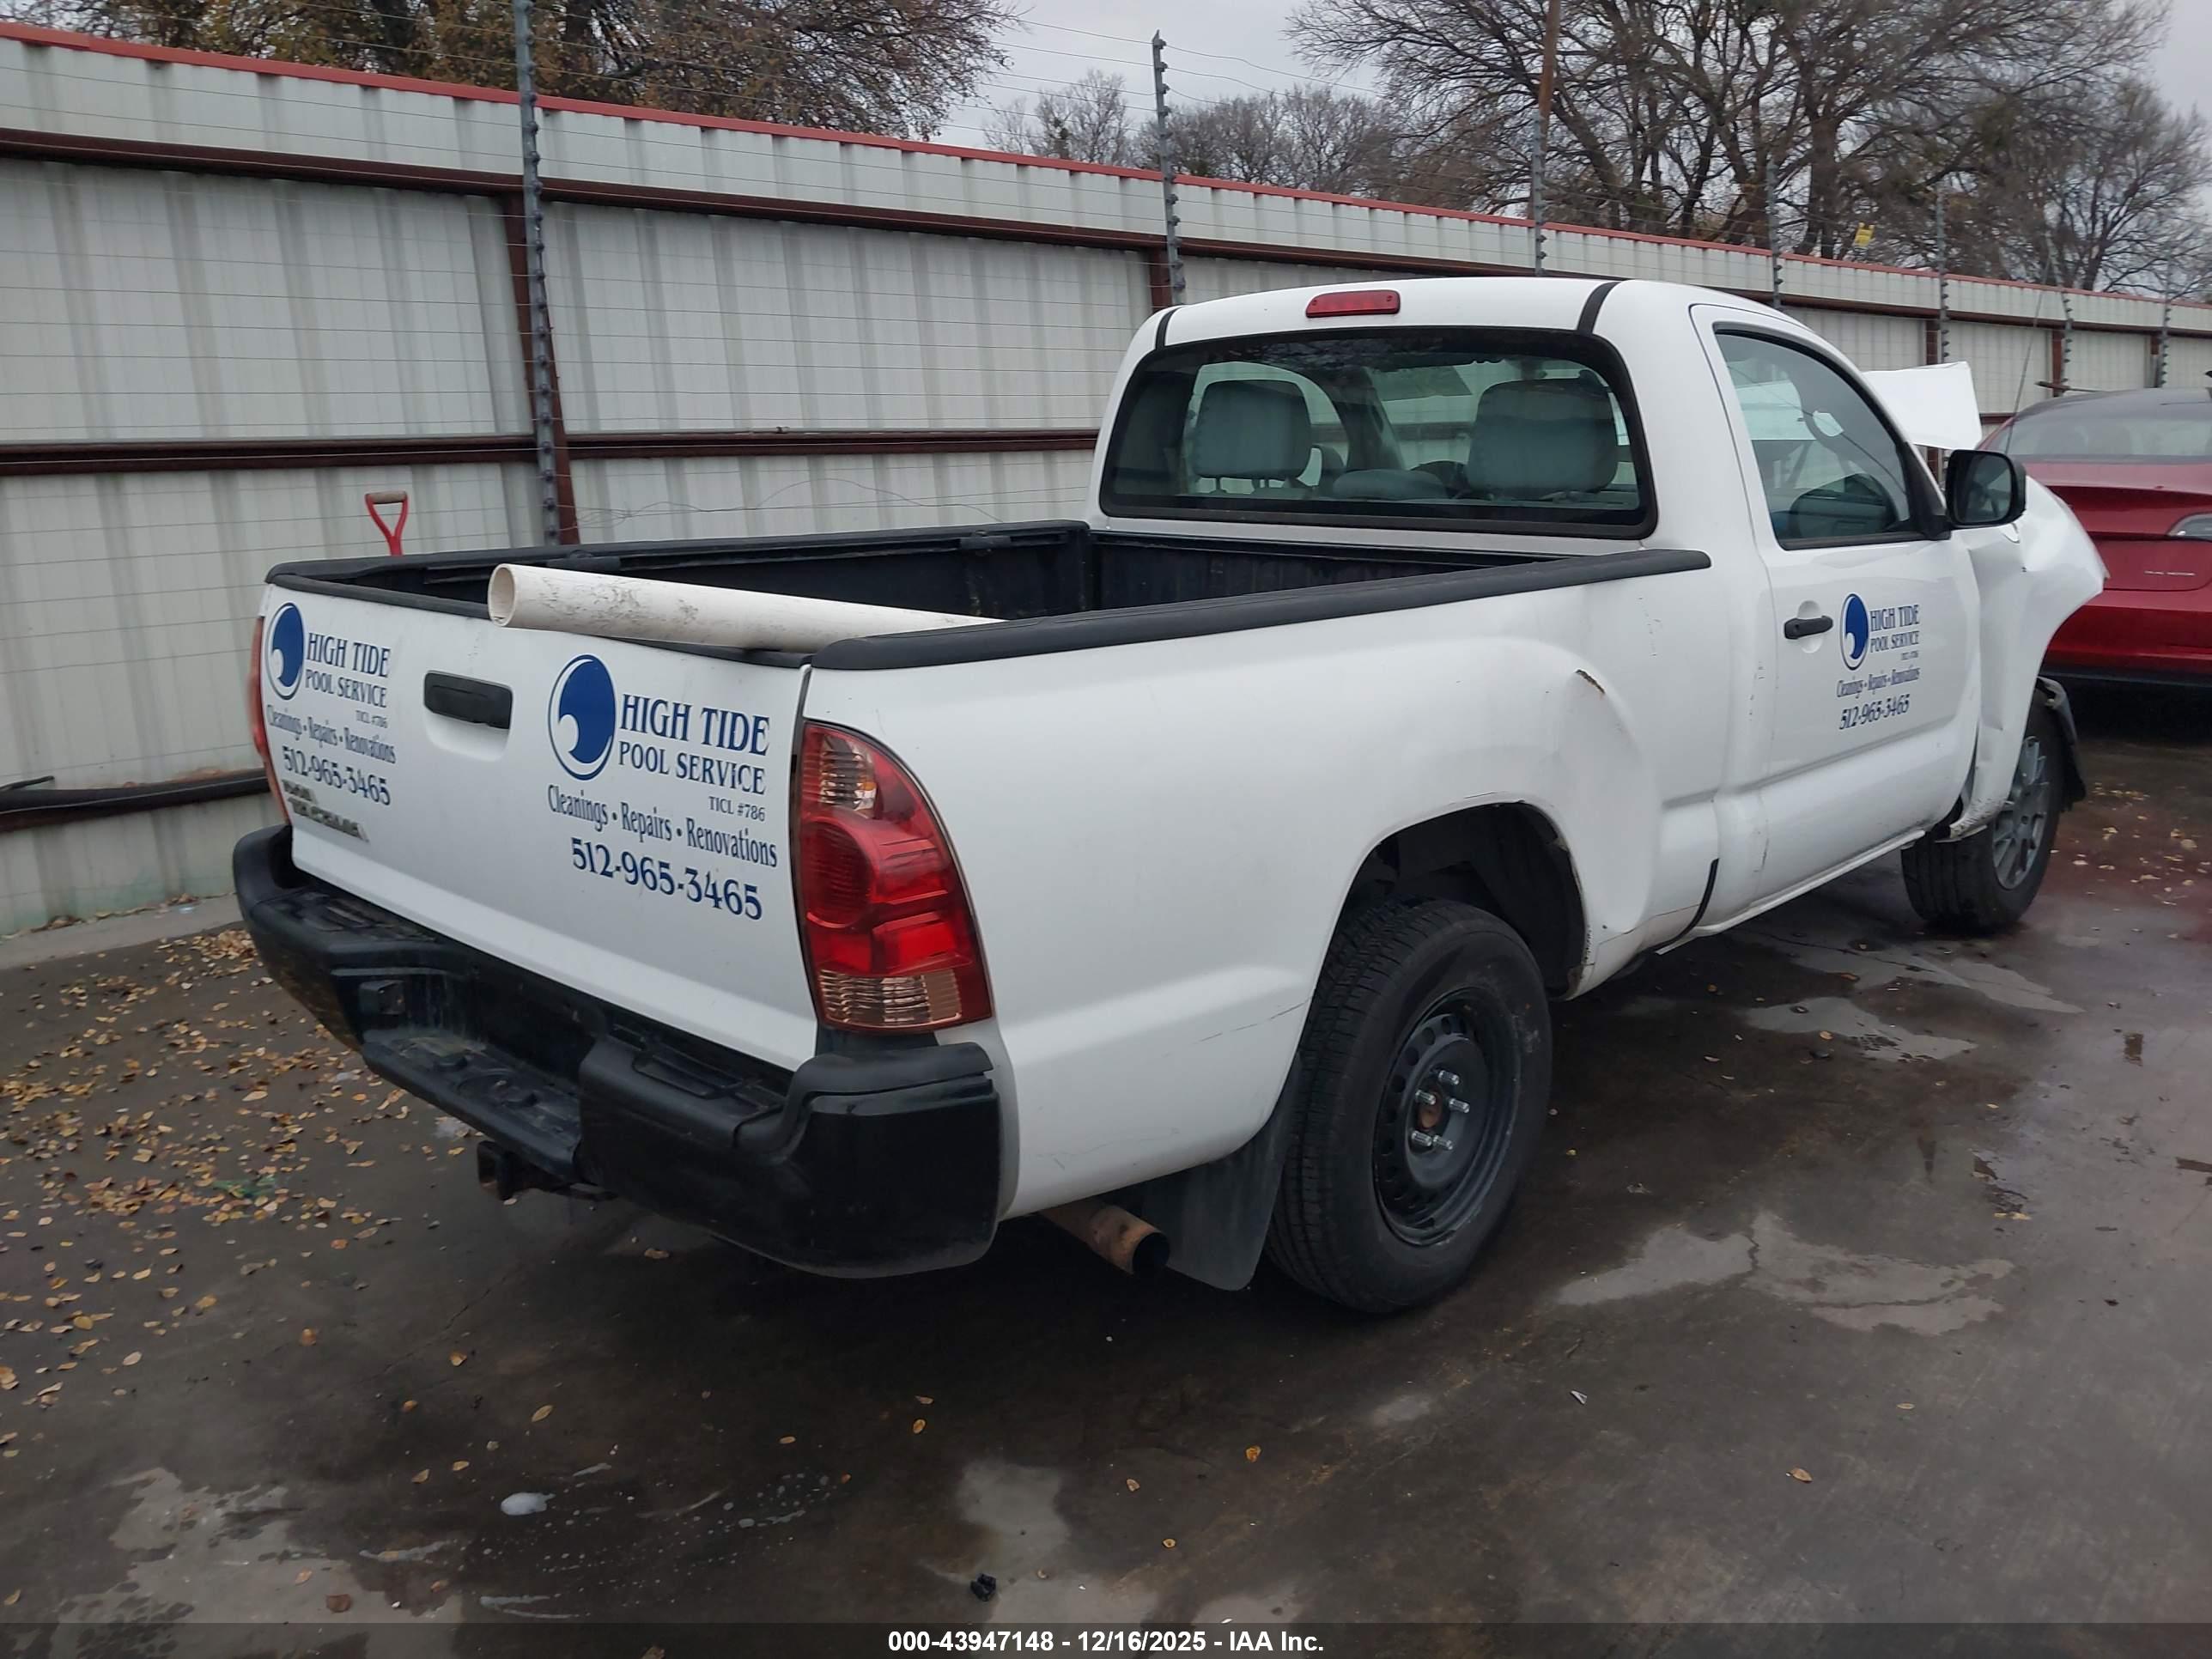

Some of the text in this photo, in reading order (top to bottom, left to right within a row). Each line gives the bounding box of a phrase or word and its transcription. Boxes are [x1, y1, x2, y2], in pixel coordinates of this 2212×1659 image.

[1869, 604, 1919, 631] HIGH TIDE
[307, 632, 391, 678] HIGH TIDE
[305, 669, 387, 708] POOL SERVICE
[618, 693, 770, 756] HIGH TIDE
[282, 745, 392, 805] 512-965-3465
[617, 740, 766, 795] POOL SERVICE
[547, 784, 777, 868] Cleanings Repairs Renovations
[708, 796, 766, 822] TICL #786
[570, 836, 763, 921] 512-965-3465
